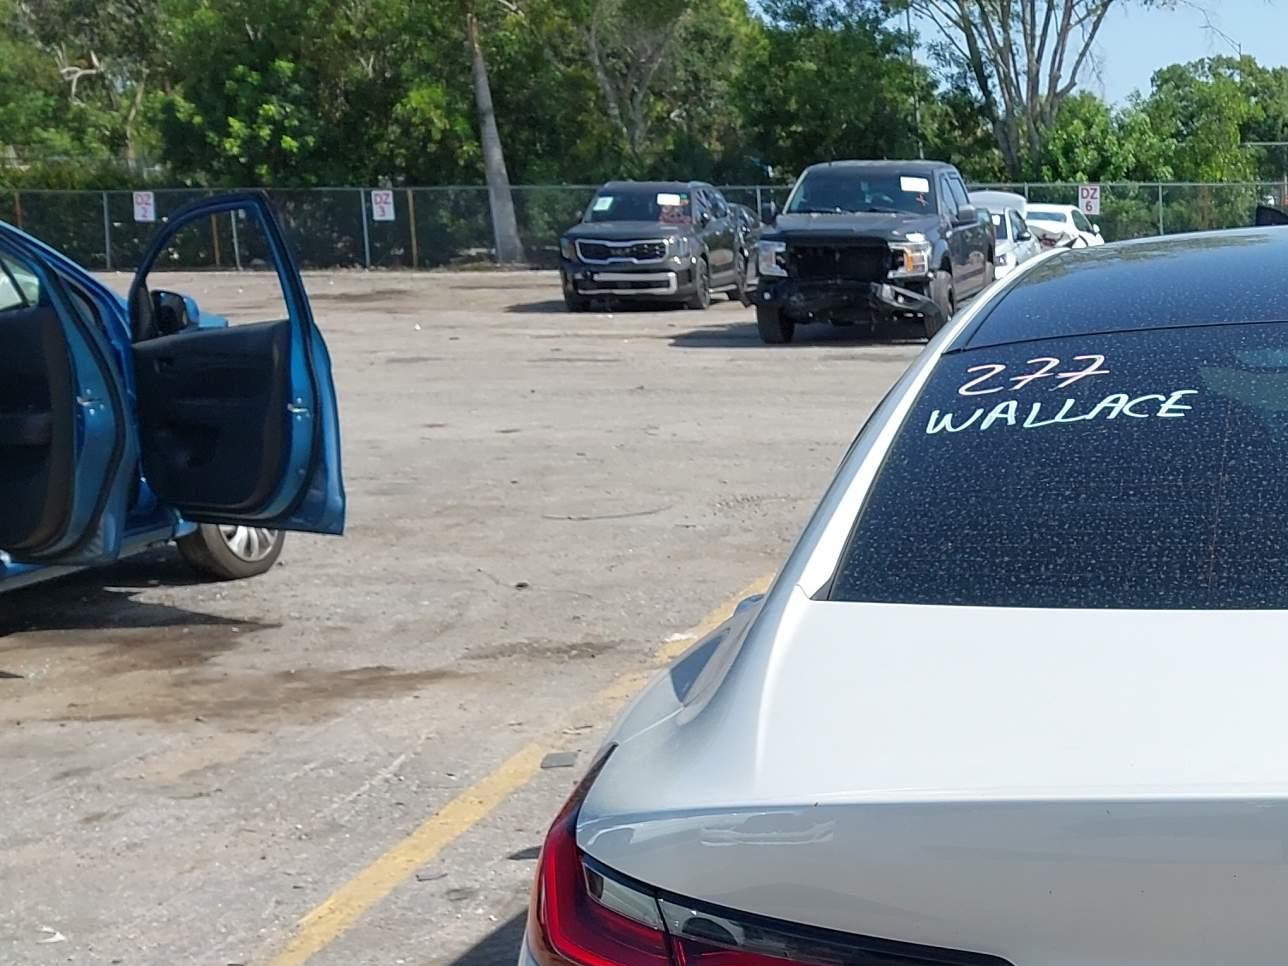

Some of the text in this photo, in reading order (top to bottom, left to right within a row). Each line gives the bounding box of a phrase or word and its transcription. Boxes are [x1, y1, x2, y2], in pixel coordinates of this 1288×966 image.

[374, 193, 391, 205] DZ
[1081, 187, 1098, 199] DZ
[1085, 201, 1093, 212] 6
[958, 354, 1110, 396] 277
[926, 390, 1198, 434] WALLACE
